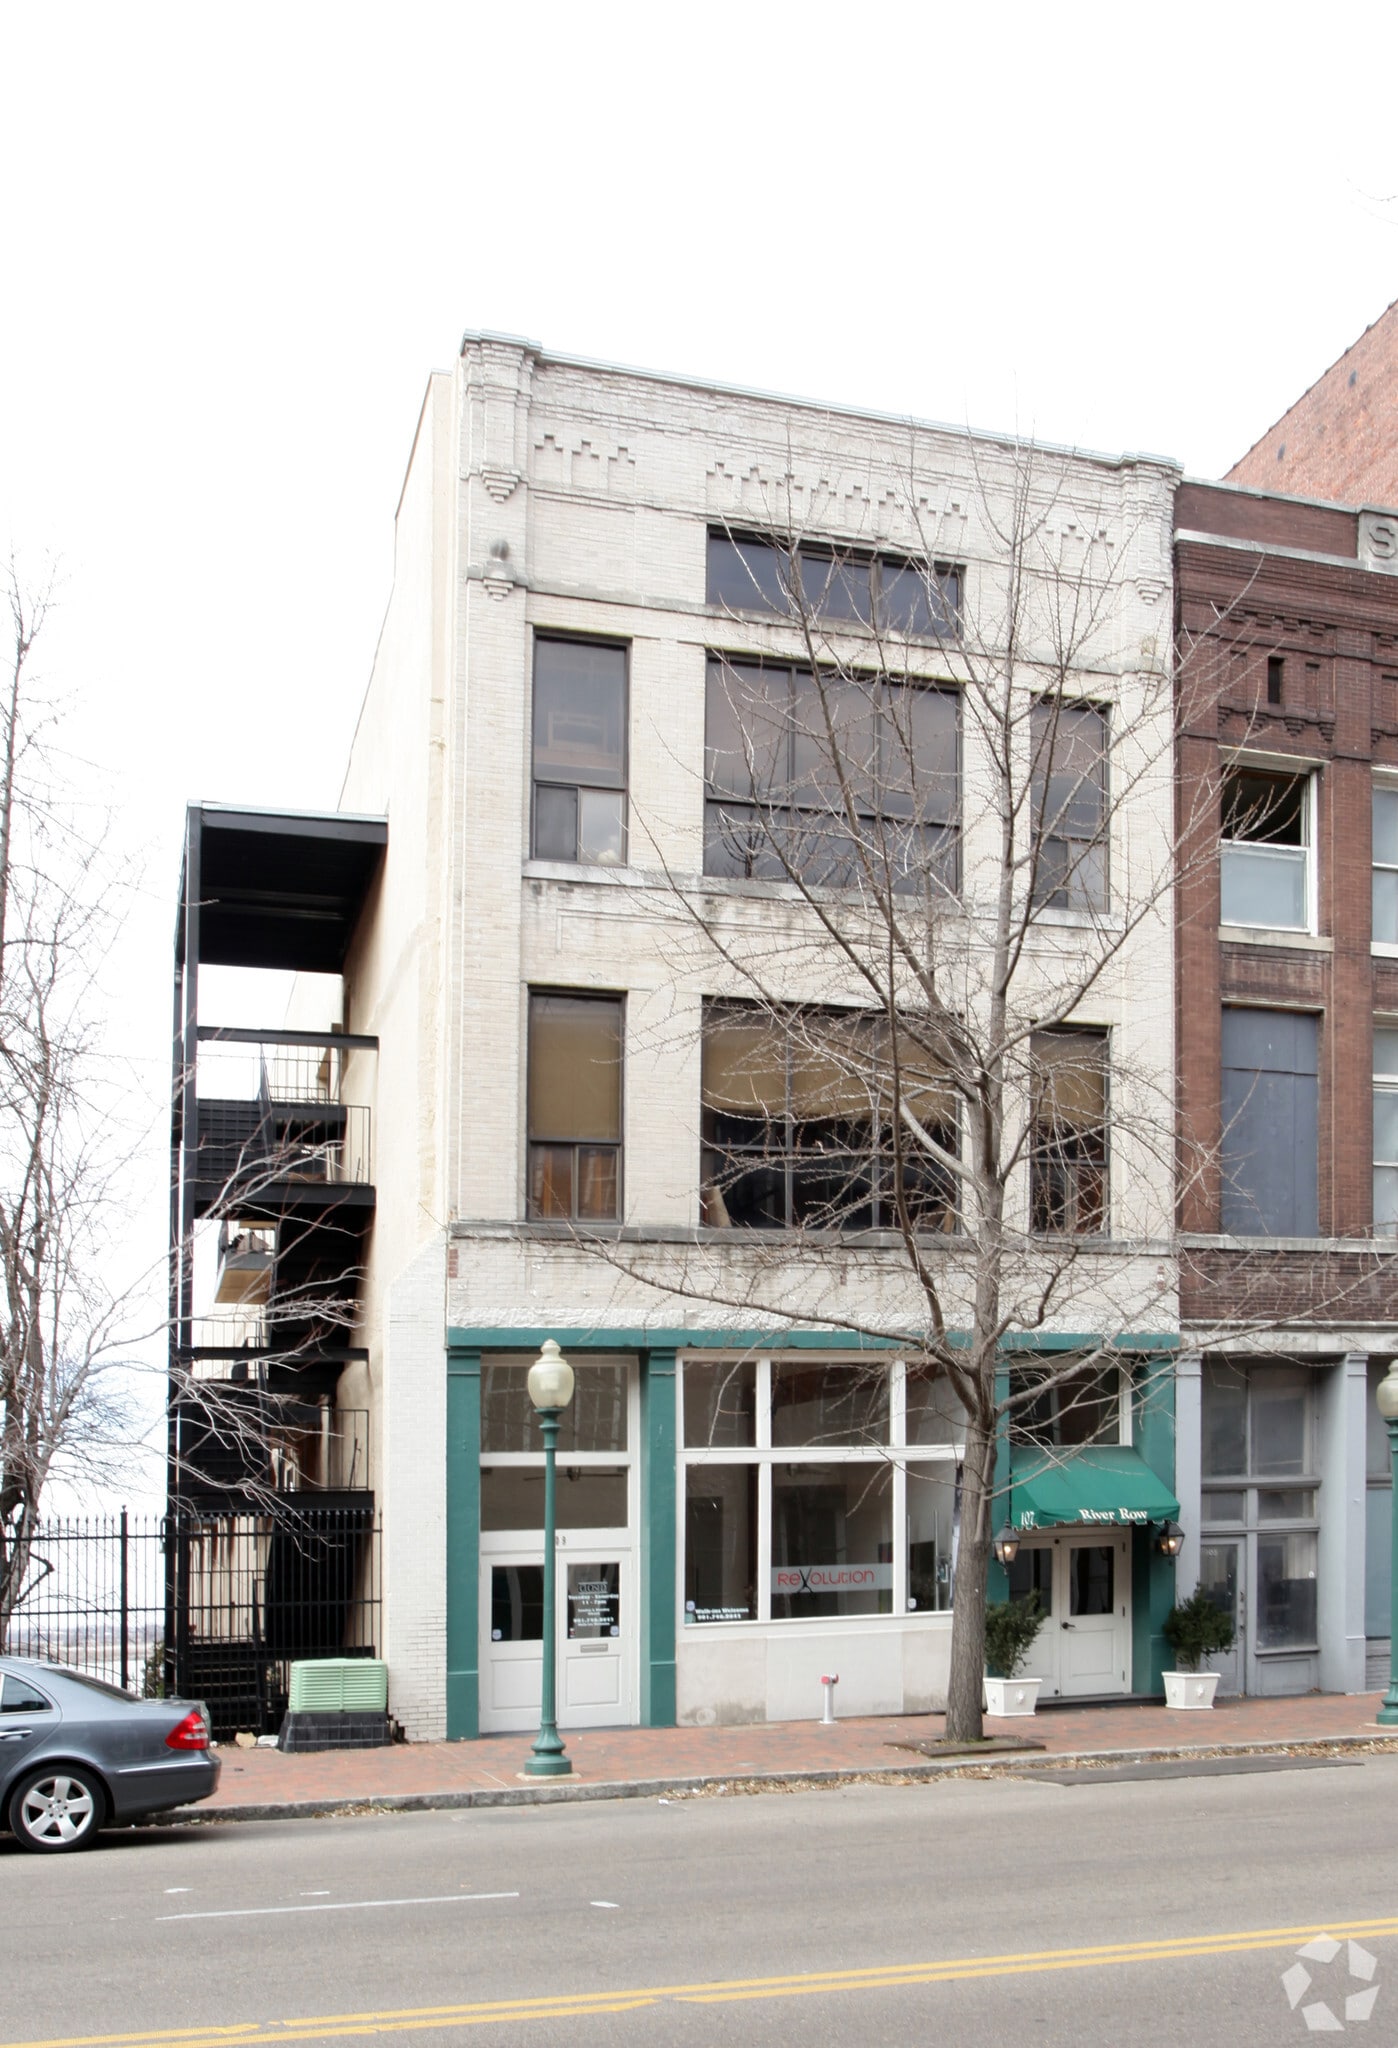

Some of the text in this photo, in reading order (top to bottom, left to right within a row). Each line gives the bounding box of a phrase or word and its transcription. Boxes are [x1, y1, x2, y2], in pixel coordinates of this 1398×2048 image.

[1368, 519, 1398, 559] S
[1021, 1510, 1035, 1526] 107
[1078, 1507, 1147, 1520] River Row
